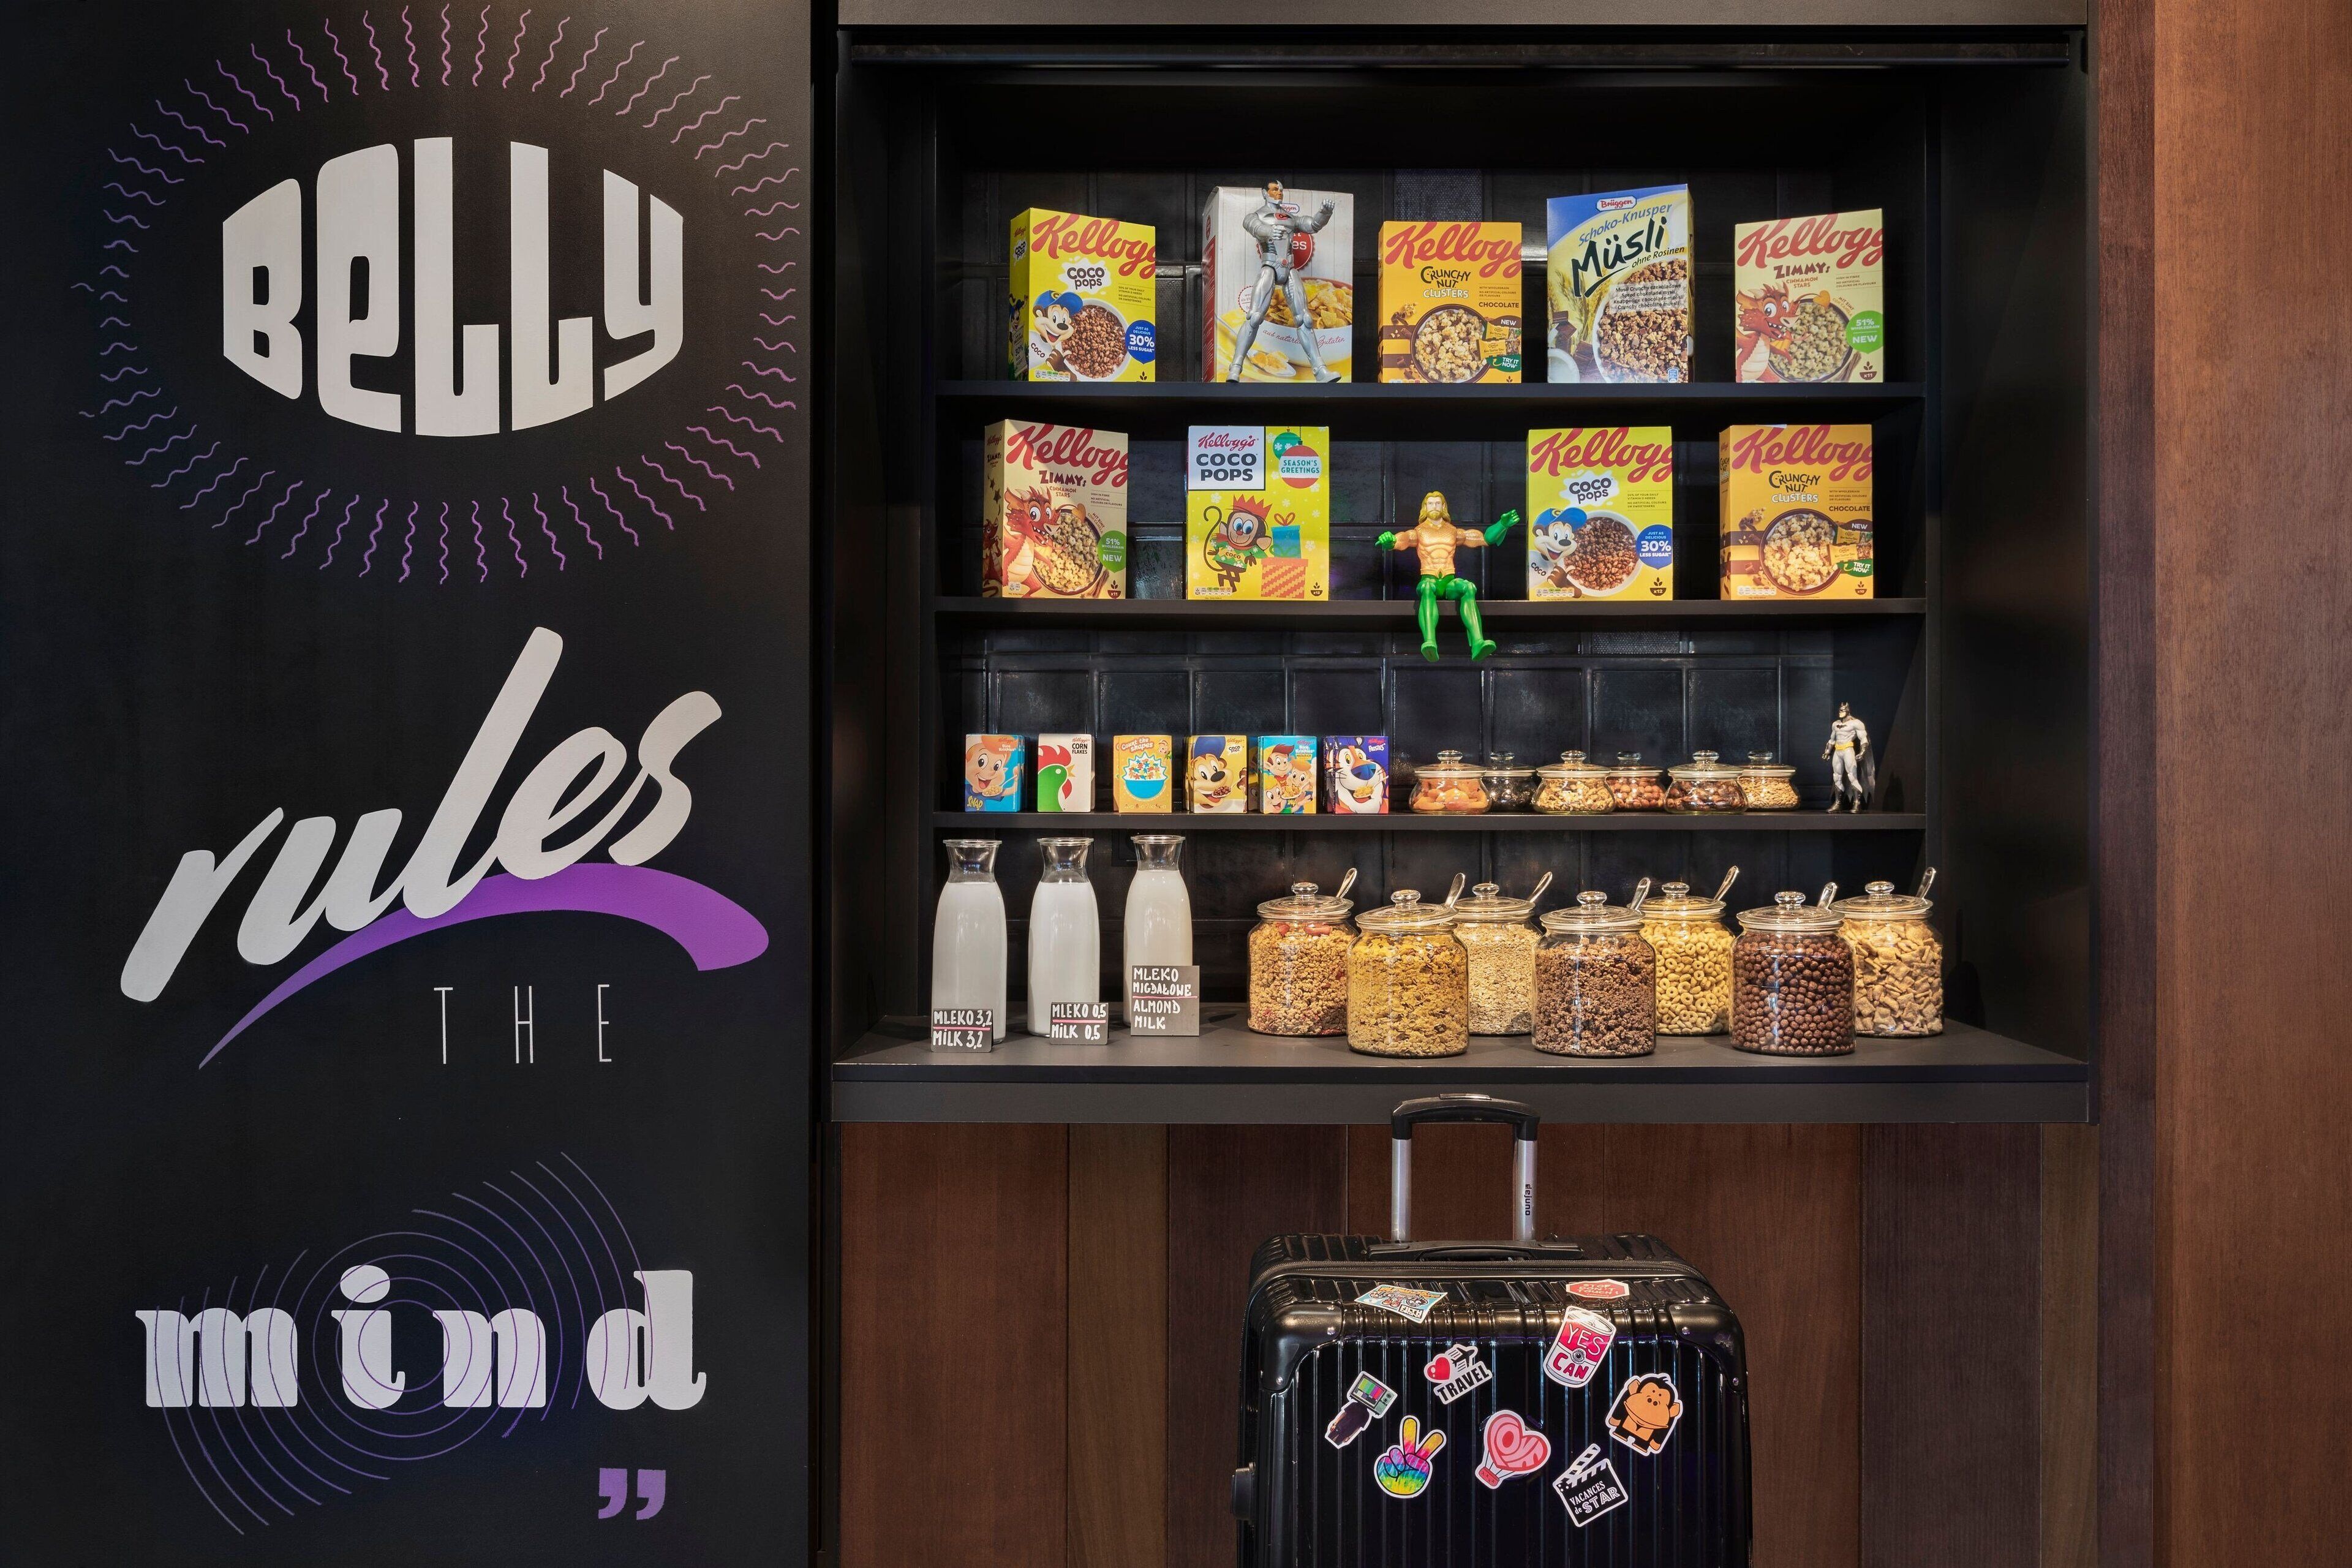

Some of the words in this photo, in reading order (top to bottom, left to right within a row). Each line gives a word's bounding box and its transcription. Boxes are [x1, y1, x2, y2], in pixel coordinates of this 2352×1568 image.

[1600, 199, 1634, 209] Brüggen
[1578, 203, 1672, 246] Schoko-Knusper
[1571, 216, 1667, 298] Müsli
[1632, 254, 1651, 268] ohne
[1653, 247, 1685, 259] Rosinen
[1423, 288, 1469, 299] CLUSTERS
[1129, 334, 1155, 347] 30%
[1852, 334, 1877, 344] NEW
[1198, 432, 1256, 451] Kellogg's
[1196, 453, 1257, 467] COCO
[1200, 469, 1253, 481] POPS
[1785, 484, 1808, 492] NUT
[1771, 492, 1819, 503] CLUSTERS
[1640, 540, 1672, 551] 30%
[1102, 554, 1122, 562] NEW
[1121, 739, 1137, 750] Count
[1130, 742, 1153, 752] shapes
[121, 627, 722, 1001] rules
[1134, 967, 1179, 982] MLEKO
[1133, 982, 1192, 997] MIGDAŁOWE
[1052, 1003, 1088, 1018] MLEKO
[1133, 999, 1181, 1014] ALMOND
[933, 1010, 974, 1025] MLEKO
[975, 1009, 992, 1027] 3,2
[1134, 1015, 1166, 1030] MILK
[966, 1030, 983, 1049] 3,2
[135, 1265, 707, 1411] mind
[1567, 1324, 1604, 1355] YES
[1553, 1352, 1589, 1379] CAN
[1438, 1364, 1490, 1401] TRAVEL
[1569, 1480, 1605, 1506] VACANCES
[1575, 1506, 1582, 1515] de
[1582, 1487, 1620, 1513] STAR
